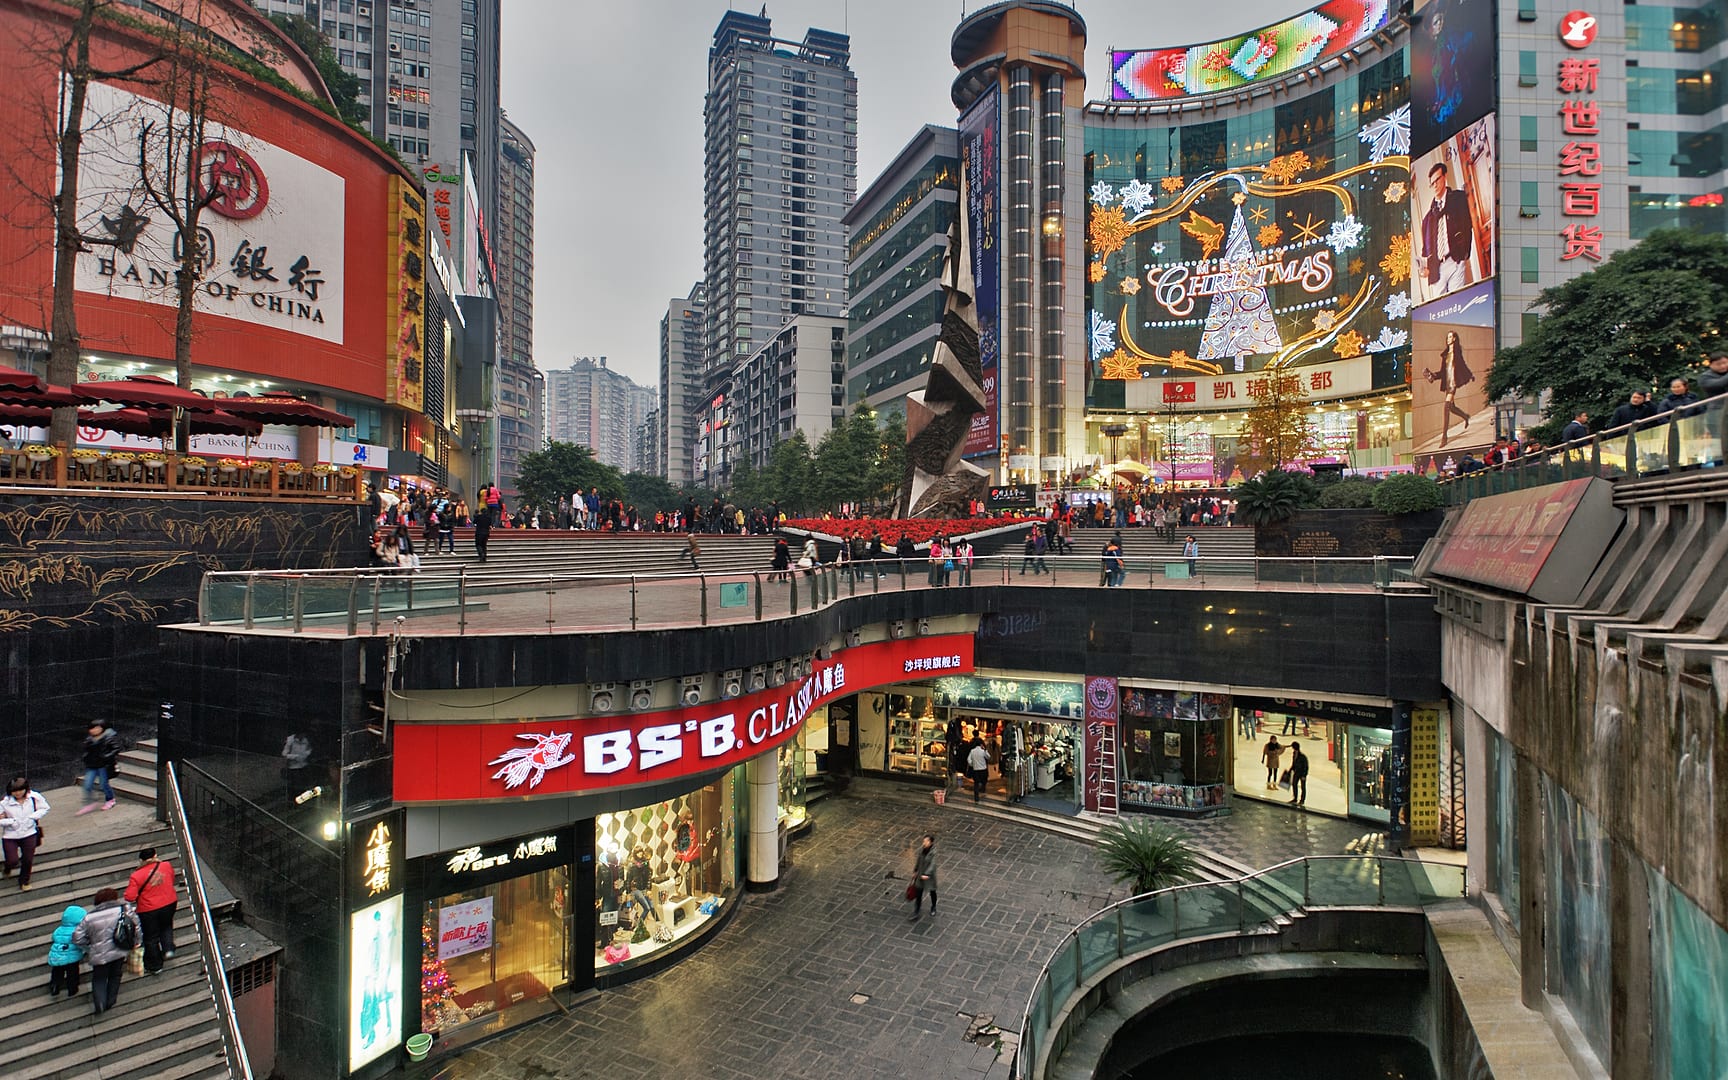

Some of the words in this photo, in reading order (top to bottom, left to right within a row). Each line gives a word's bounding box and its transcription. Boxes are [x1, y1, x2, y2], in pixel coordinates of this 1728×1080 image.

[1158, 29, 1279, 74] 陶然居
[1558, 57, 1603, 261] 新世纪百货
[983, 190, 994, 249] 新中心
[206, 281, 239, 301] OF
[251, 291, 325, 324] CHINA
[1147, 249, 1333, 316] CHRISTMAS
[1437, 303, 1462, 319] saunda
[208, 437, 238, 448] BANK
[257, 442, 291, 452] CHINA
[904, 655, 961, 673] 沙坪坝旗舰店
[748, 674, 815, 744] CLASSIC
[813, 662, 846, 700] 小魔鱼
[1330, 706, 1355, 716] man's
[1356, 709, 1377, 719] zone
